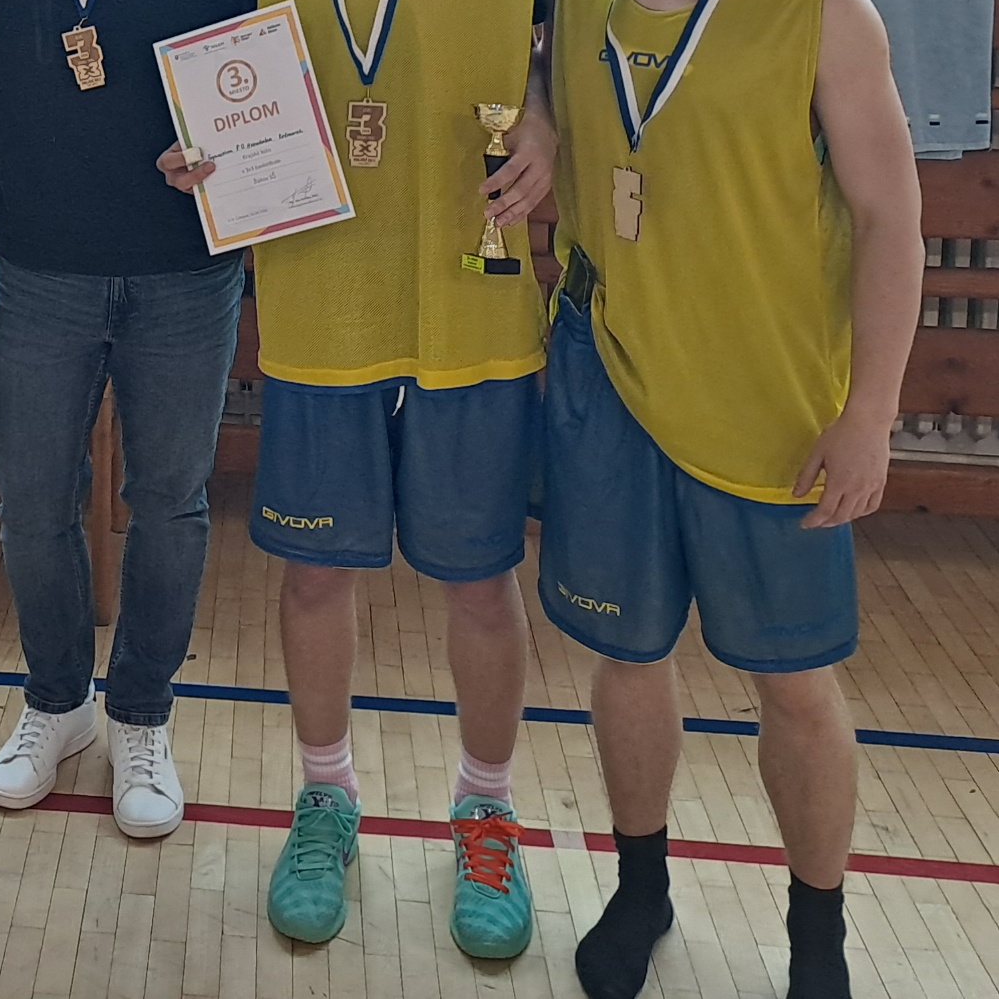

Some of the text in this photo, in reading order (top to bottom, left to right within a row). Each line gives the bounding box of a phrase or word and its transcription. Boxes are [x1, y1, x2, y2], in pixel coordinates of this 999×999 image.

[227, 66, 249, 88] 3.
[214, 101, 280, 132] DIPLOM
[262, 506, 334, 530] GIVOVA
